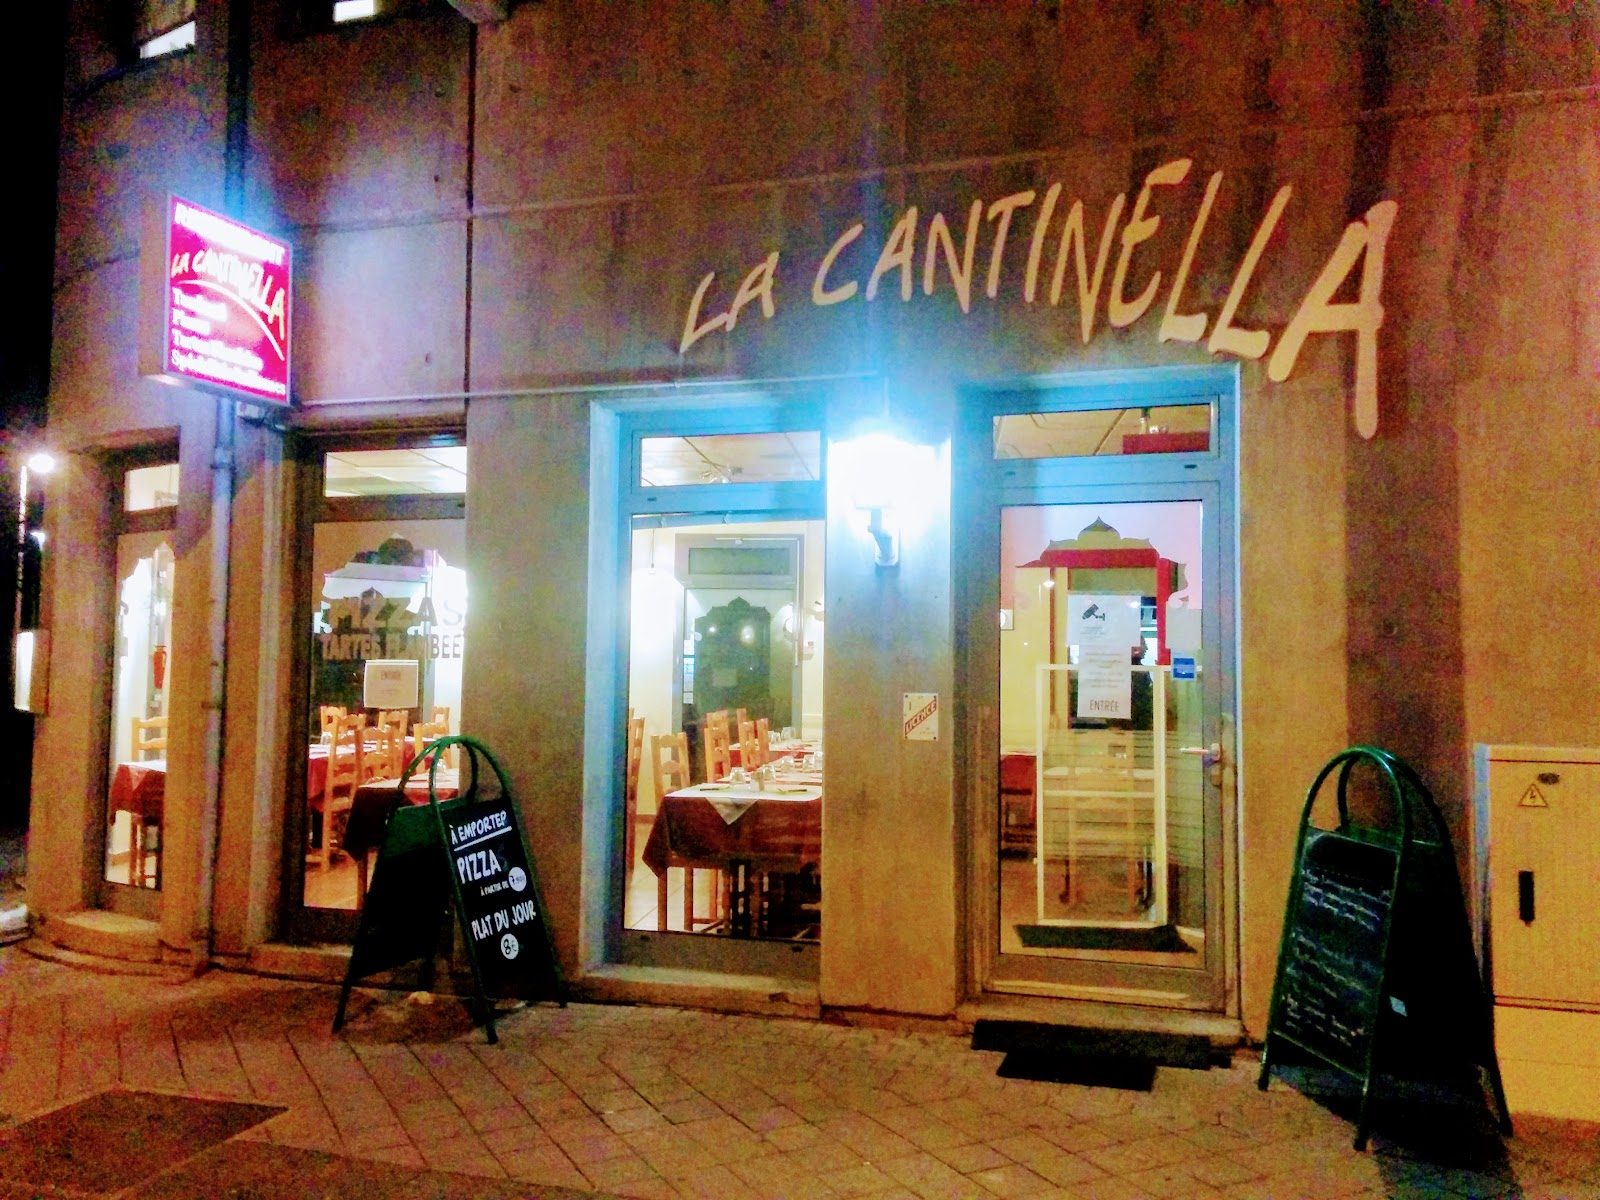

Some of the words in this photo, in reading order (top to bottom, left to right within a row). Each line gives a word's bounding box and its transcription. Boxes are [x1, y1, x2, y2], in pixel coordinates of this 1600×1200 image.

[171, 252, 190, 278] LA
[192, 247, 286, 340] CANTINELLA
[680, 253, 780, 355] LA
[811, 157, 1399, 440] CANTINELLA
[449, 825, 458, 845] À
[457, 810, 508, 842] EMPORTER
[456, 849, 502, 885] PIZZA
[471, 914, 494, 942] PLAT
[494, 908, 510, 932] DU
[512, 899, 537, 926] JOUR
